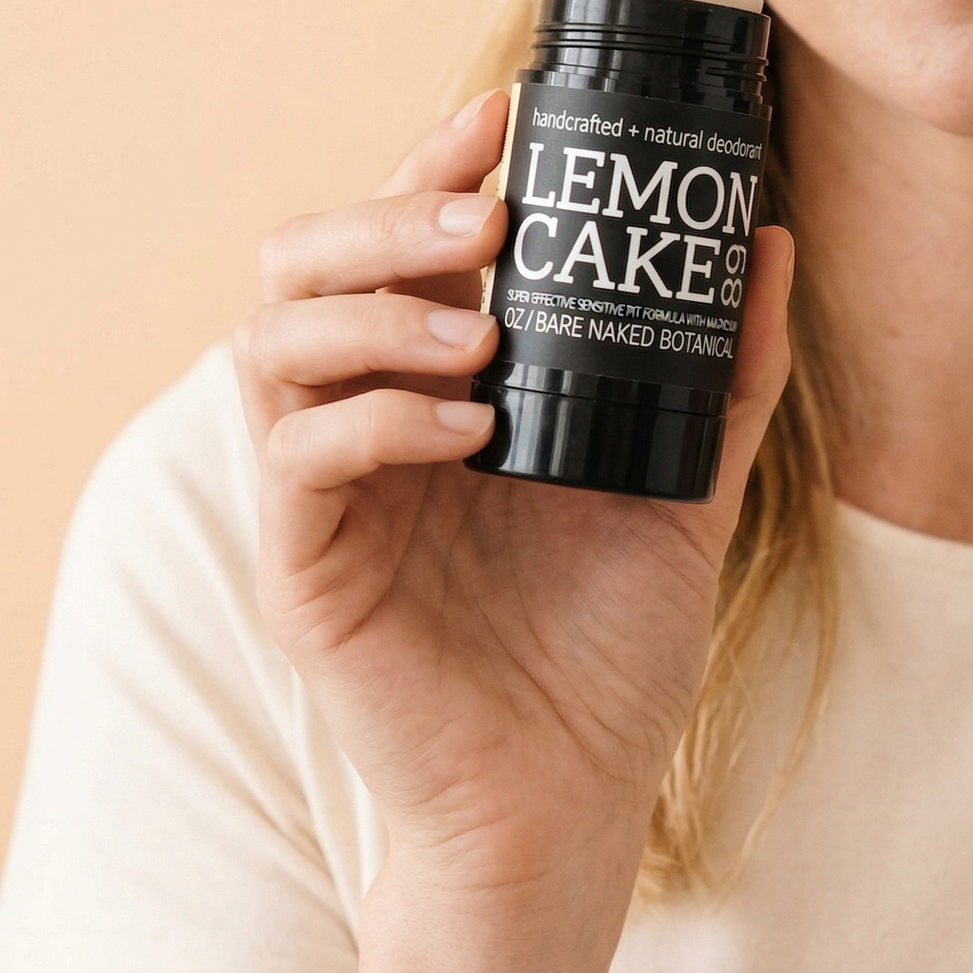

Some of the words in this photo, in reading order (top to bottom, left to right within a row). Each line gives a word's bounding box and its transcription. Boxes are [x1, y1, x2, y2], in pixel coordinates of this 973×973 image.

[532, 107, 623, 137] handcrafted
[628, 124, 640, 138] +
[644, 126, 704, 149] natural
[522, 142, 758, 237] LEMON
[513, 213, 721, 304] CAKE
[588, 318, 655, 348] NAKED
[659, 329, 734, 359] BOTANICAL
